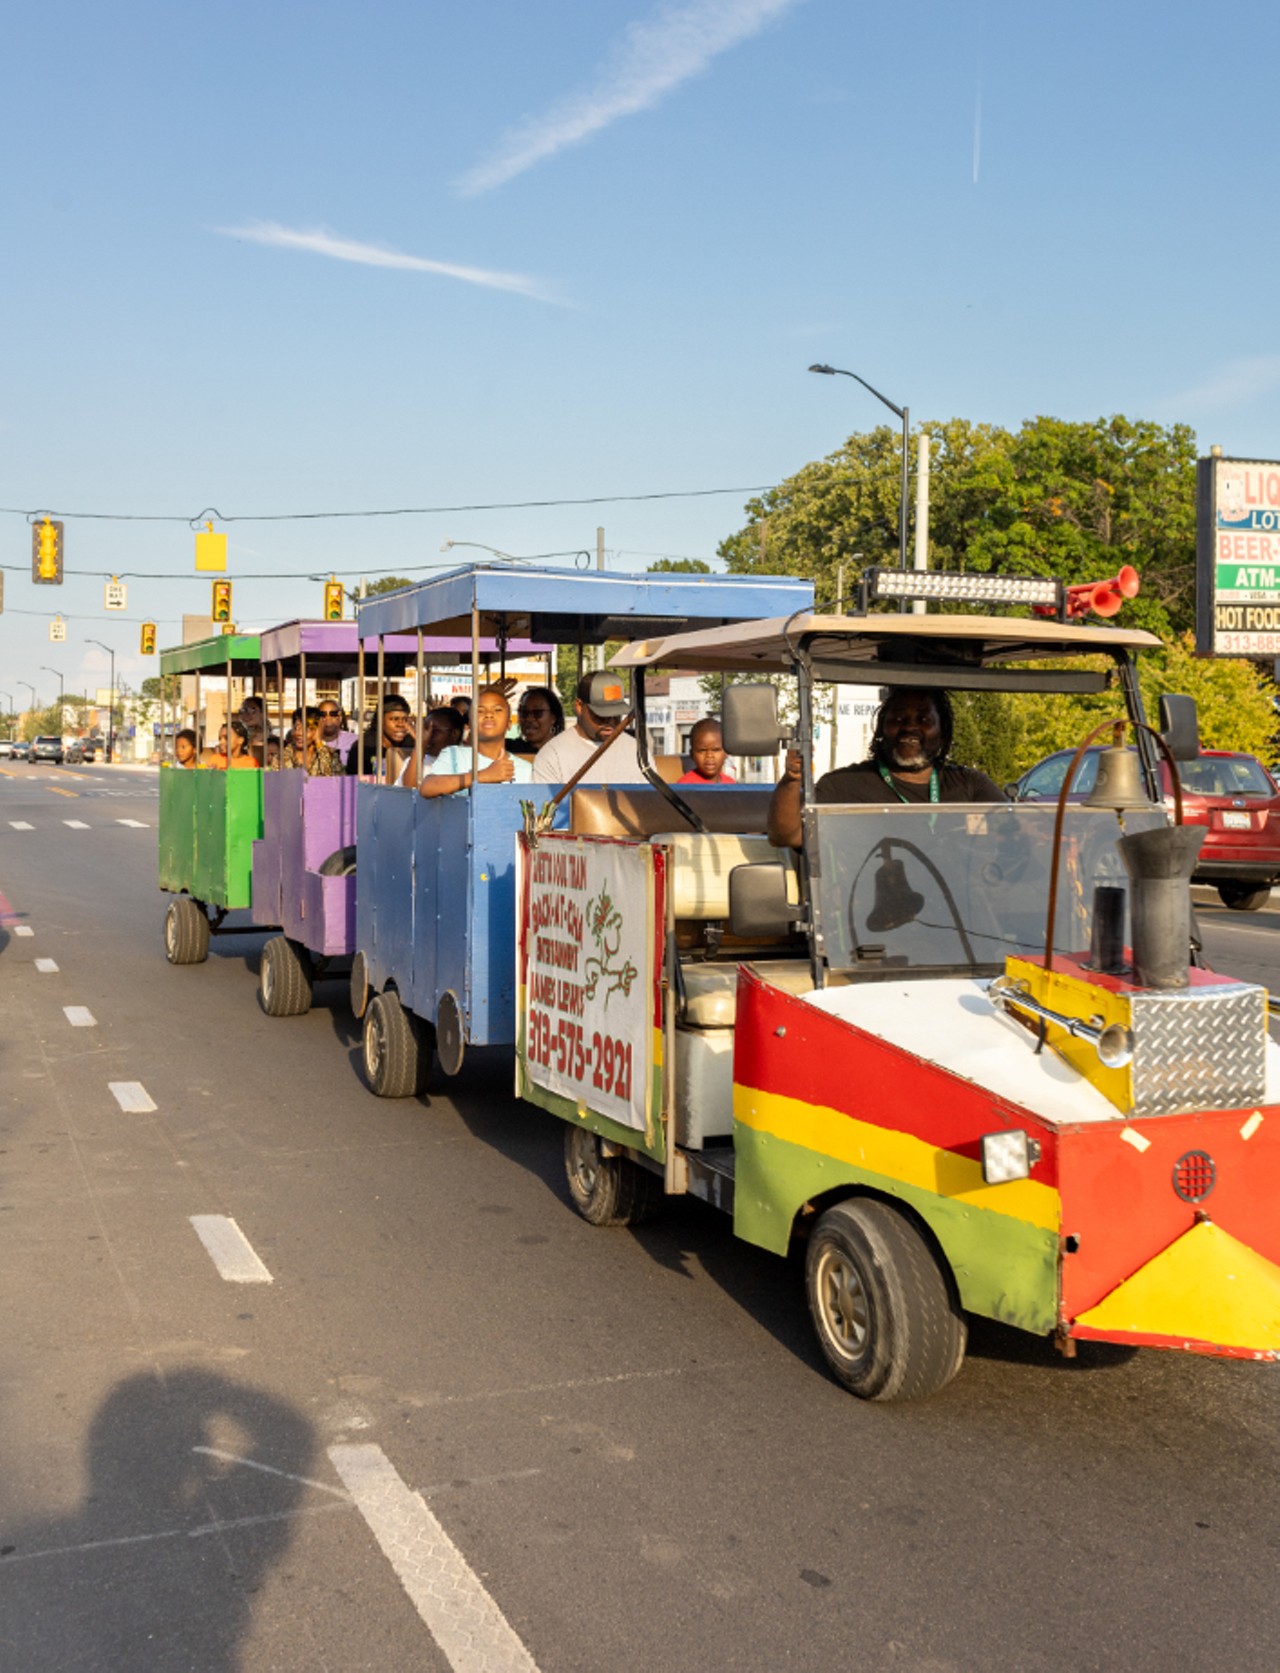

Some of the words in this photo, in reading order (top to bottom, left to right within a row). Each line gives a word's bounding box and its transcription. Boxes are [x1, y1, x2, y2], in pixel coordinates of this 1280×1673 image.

[1219, 535, 1280, 561] BEER-
[1216, 606, 1243, 629] HOT
[530, 971, 555, 1011] JAMES
[528, 1009, 632, 1102] 313-575-2921
